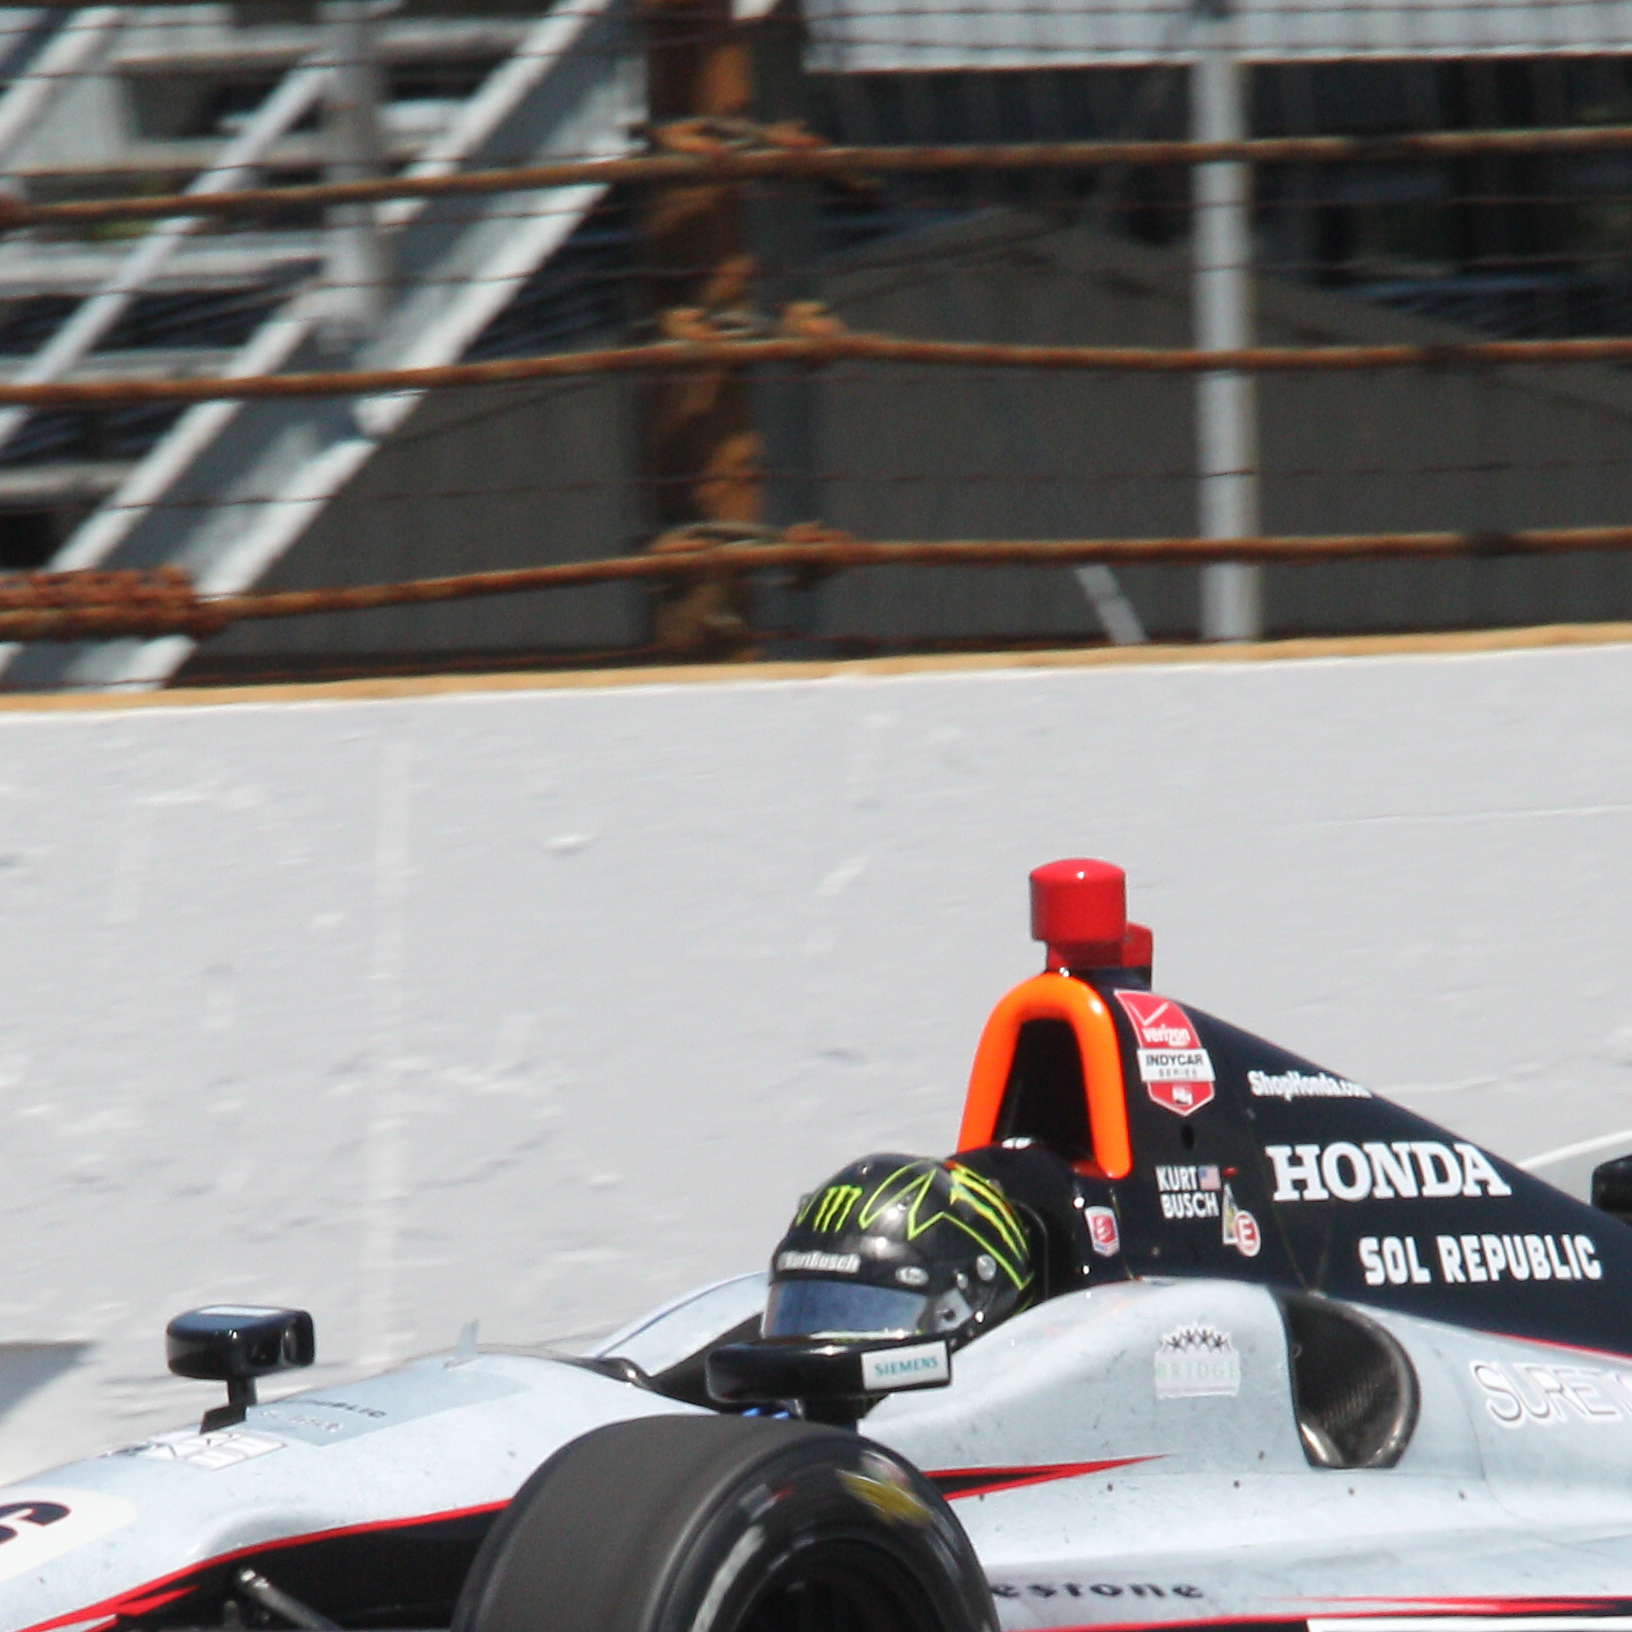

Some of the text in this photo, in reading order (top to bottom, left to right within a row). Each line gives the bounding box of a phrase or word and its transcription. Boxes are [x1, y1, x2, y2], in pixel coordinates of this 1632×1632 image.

[1142, 1025, 1191, 1046] verizon
[1146, 1054, 1203, 1066] INDYCAR
[1155, 1165, 1198, 1191] KURT
[1265, 1141, 1512, 1201] HONDA
[1161, 1192, 1219, 1219] BUSCH
[1358, 1234, 1602, 1286] SOL REPUBLIC
[874, 1356, 939, 1377] SIEMENS
[1156, 1359, 1242, 1379] BRIDGE
[989, 1582, 1204, 1600] estone
